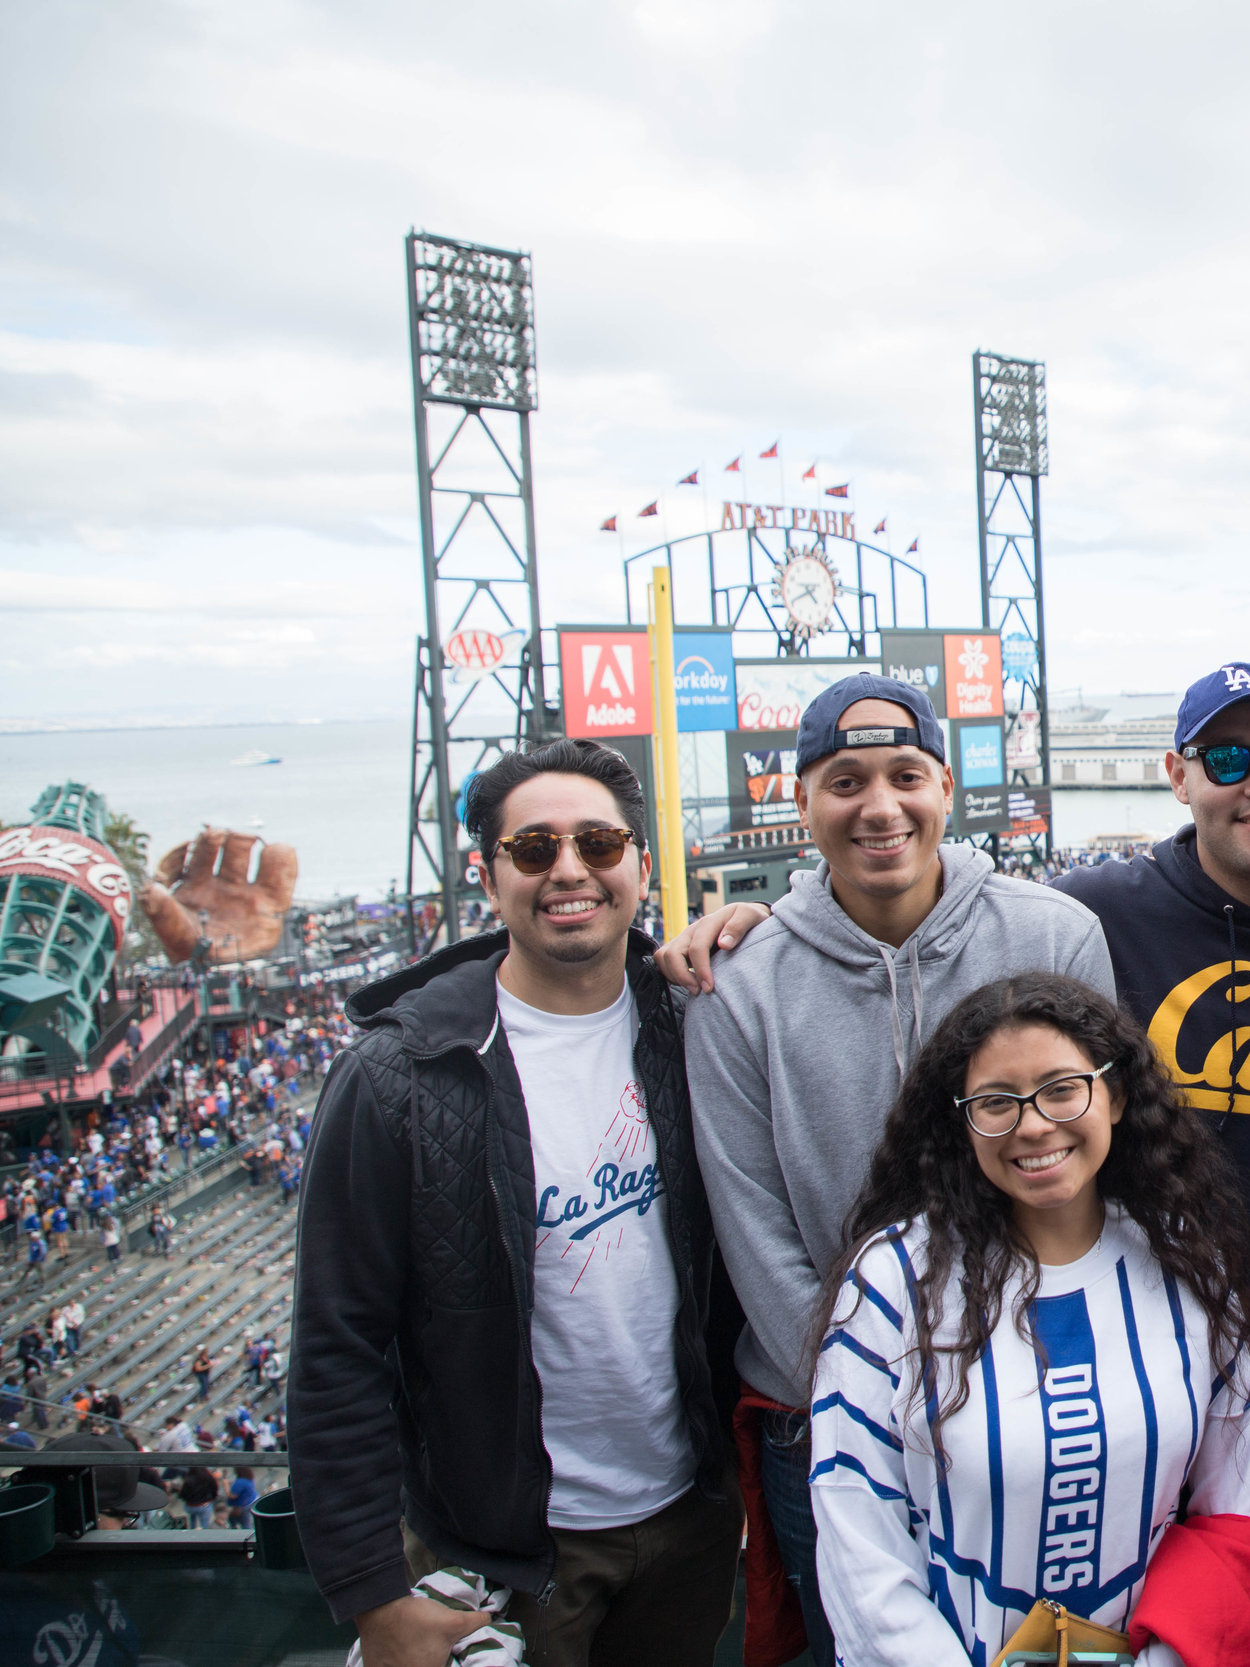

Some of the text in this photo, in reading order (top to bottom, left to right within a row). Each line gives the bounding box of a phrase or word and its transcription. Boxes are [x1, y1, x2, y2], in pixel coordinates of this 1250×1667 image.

[721, 500, 856, 542] AT&T PARK
[453, 631, 500, 668] AAA
[673, 670, 728, 692] orkday
[888, 664, 924, 685] blue
[956, 682, 993, 702] Dignity
[586, 703, 637, 727] Adobe
[740, 692, 800, 731] Coor
[958, 700, 993, 715] Health
[536, 1185, 588, 1229] La
[1043, 1363, 1101, 1593] DODGERS
